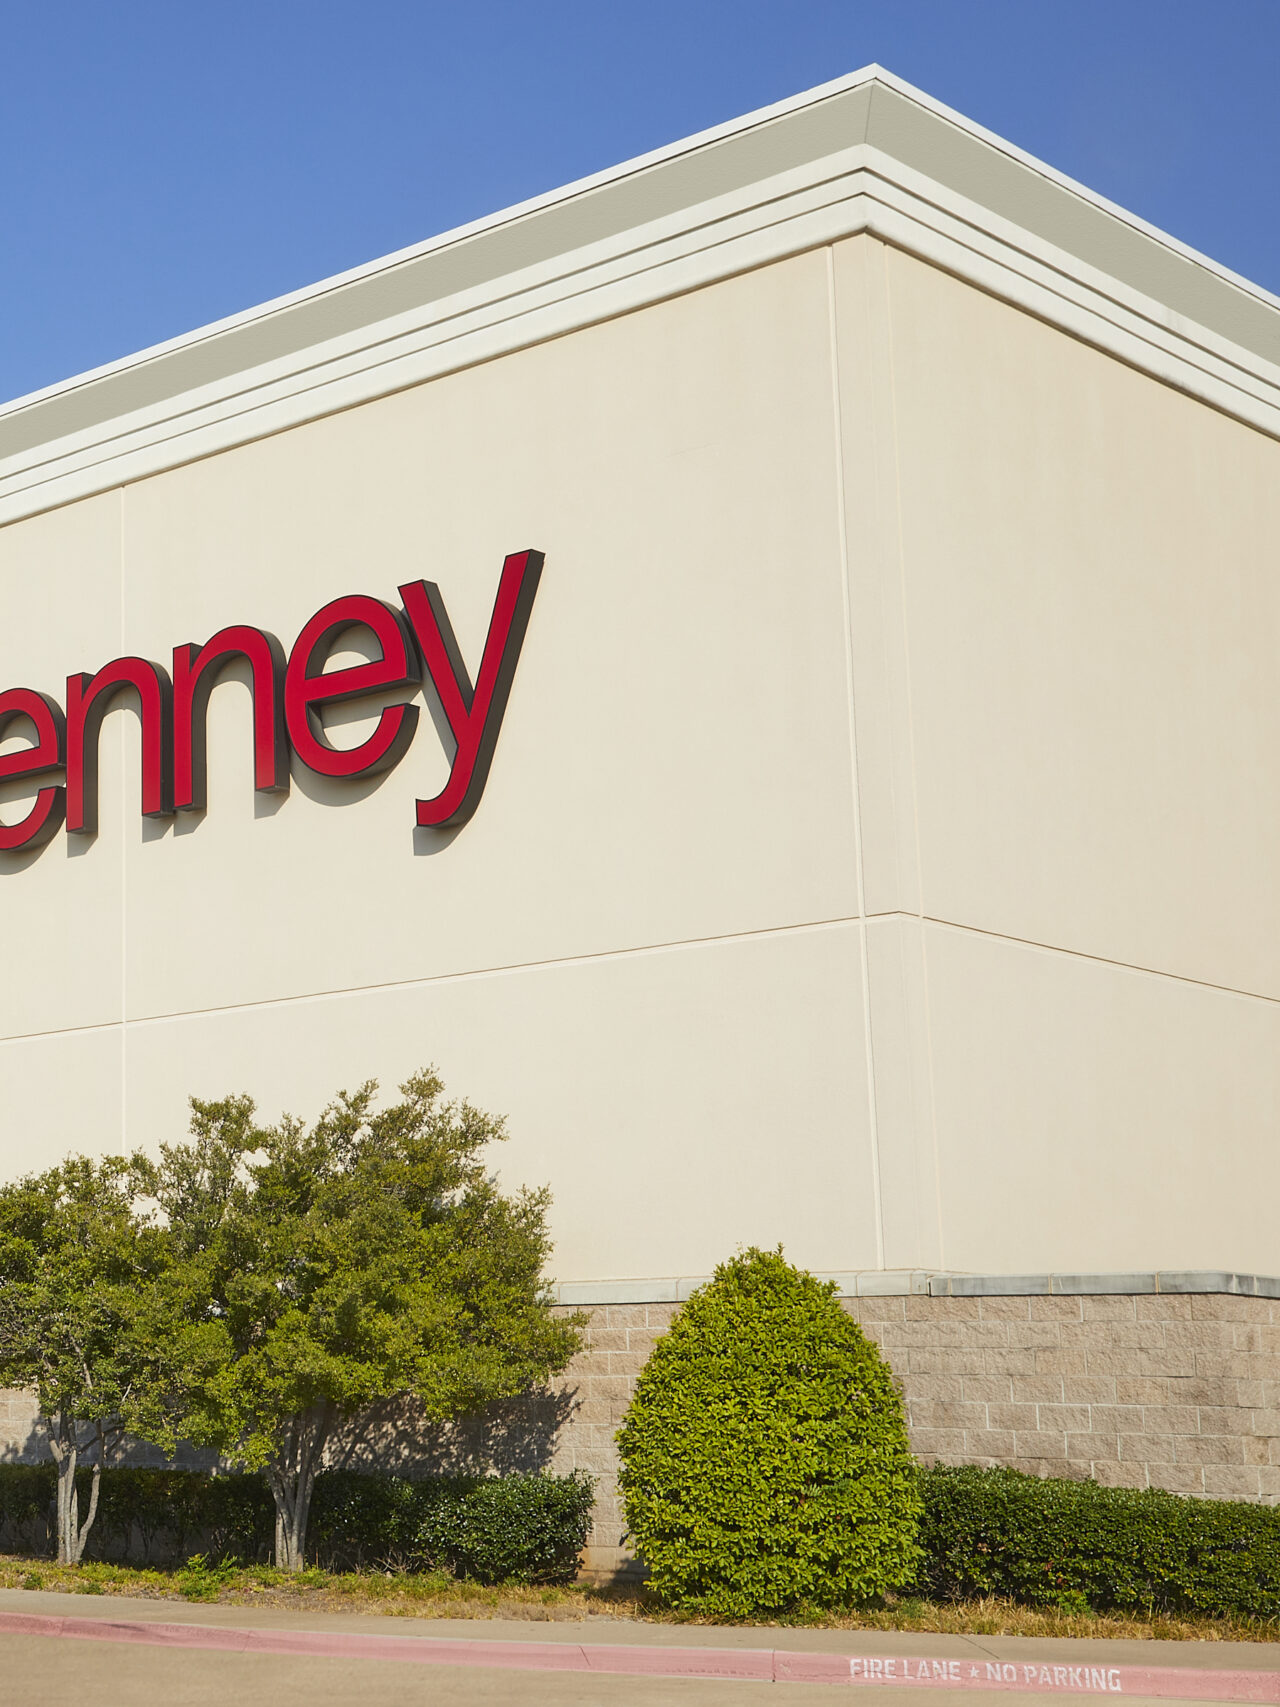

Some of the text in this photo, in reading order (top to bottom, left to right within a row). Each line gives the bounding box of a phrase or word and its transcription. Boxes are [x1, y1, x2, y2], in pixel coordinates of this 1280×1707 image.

[849, 1658, 1122, 1691] FIRE LANE NO PARKING
